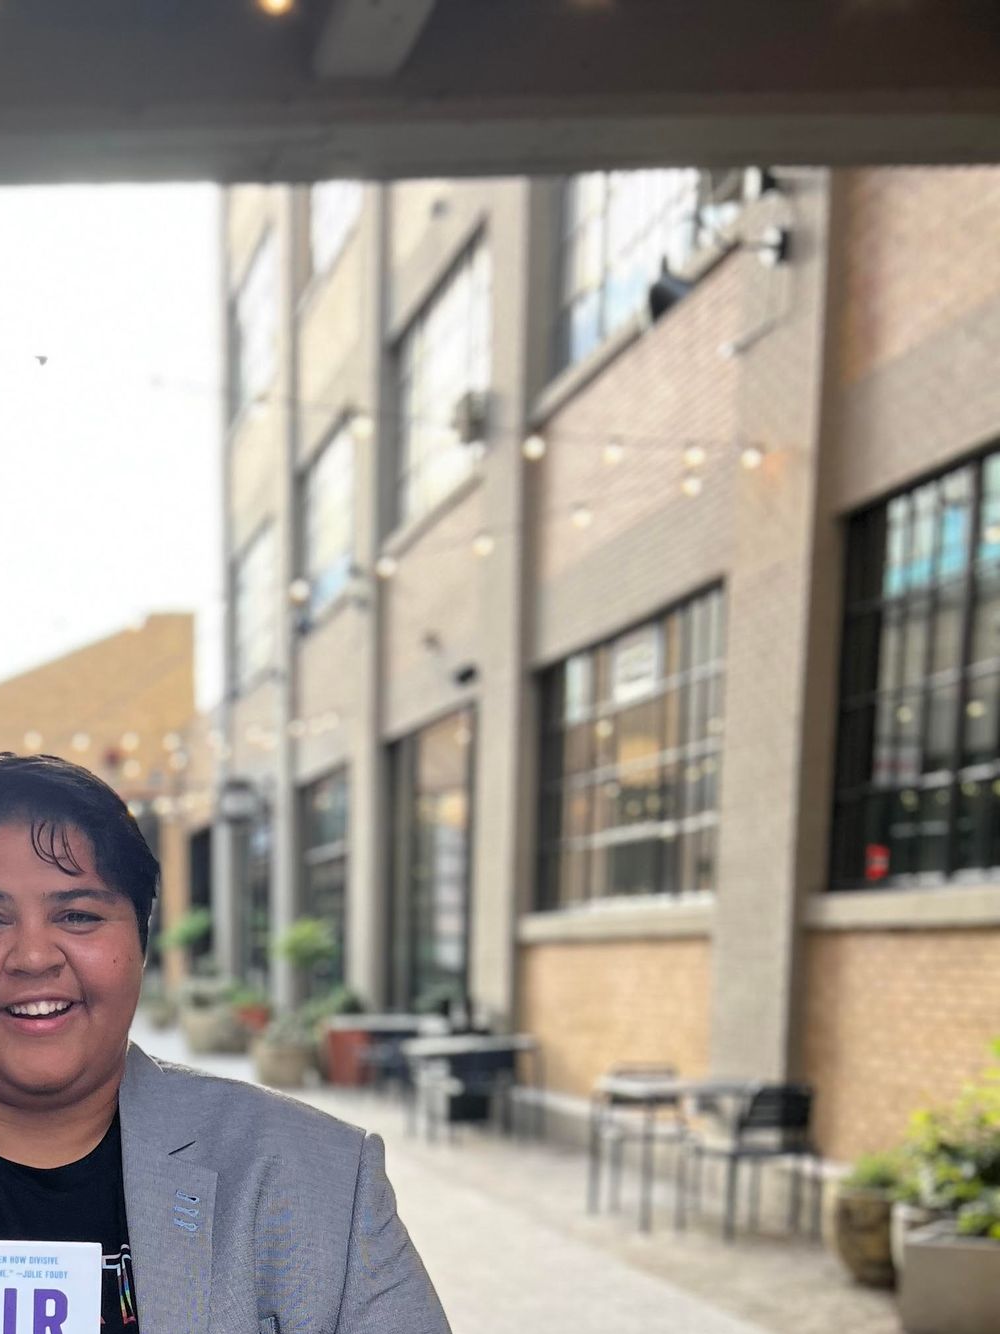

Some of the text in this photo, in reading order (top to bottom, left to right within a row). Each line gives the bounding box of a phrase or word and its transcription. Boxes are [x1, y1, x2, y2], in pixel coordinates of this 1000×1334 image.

[9, 1255, 27, 1264] HOW
[29, 1256, 59, 1265] DIVISIVE
[45, 1270, 68, 1279] FOUDY
